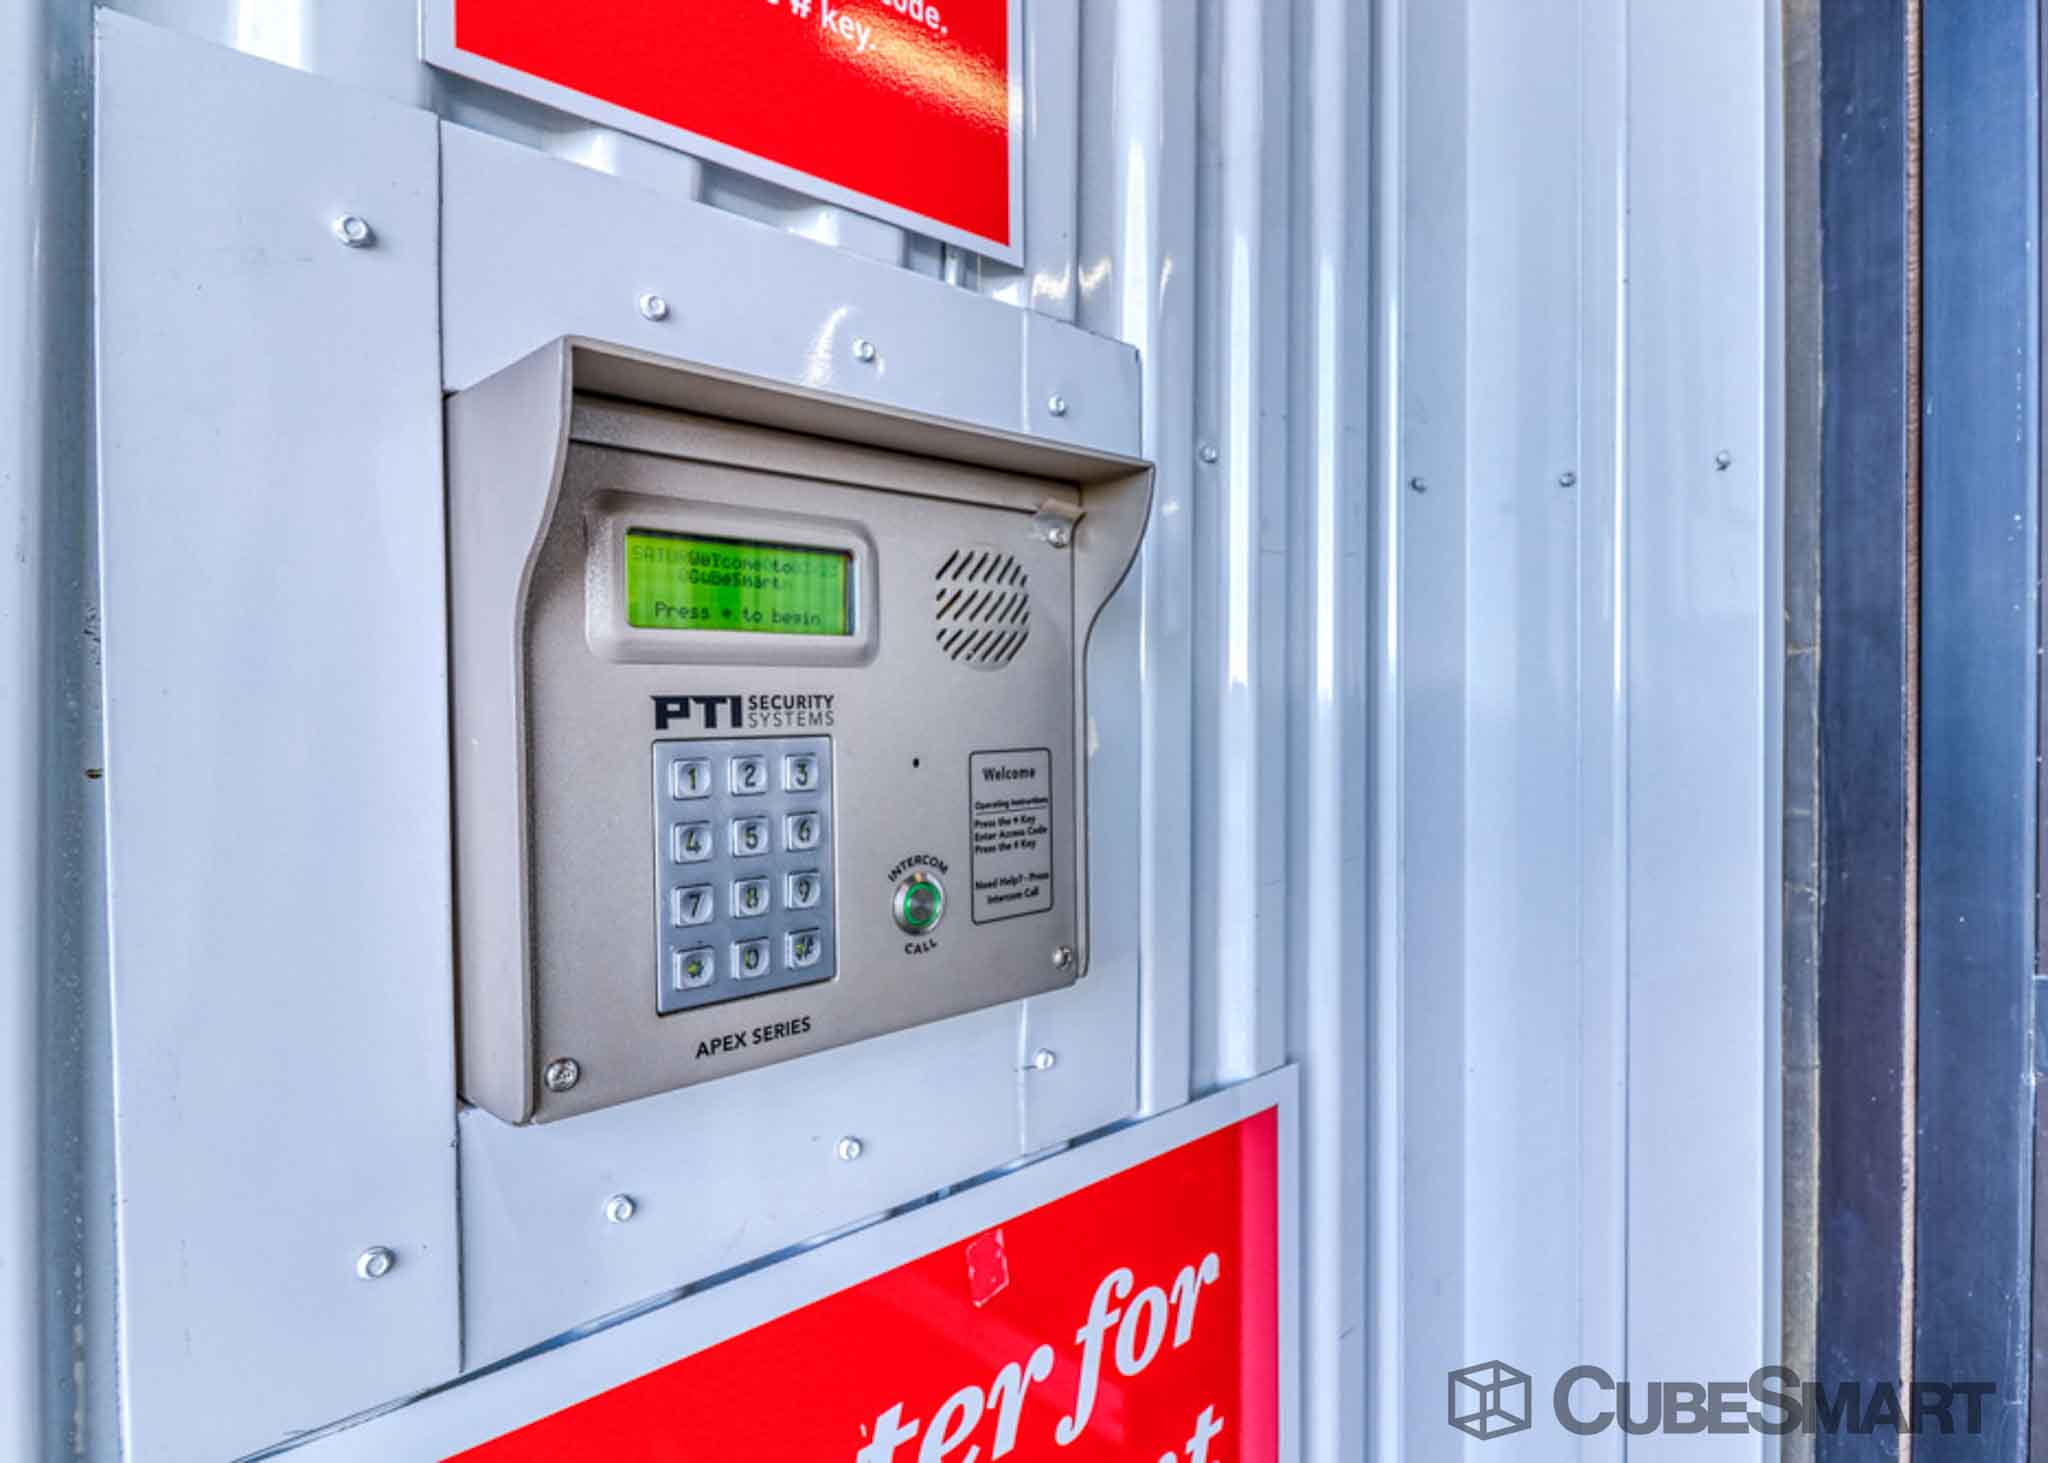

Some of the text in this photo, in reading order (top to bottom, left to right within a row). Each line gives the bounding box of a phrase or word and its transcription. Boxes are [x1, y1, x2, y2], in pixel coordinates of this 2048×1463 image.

[820, 0, 877, 53] key.
[881, 0, 948, 35] ode.
[688, 549, 762, 572] Welcome
[771, 557, 793, 576] to
[654, 601, 710, 621] Press
[743, 609, 763, 625] to
[772, 608, 822, 627] begin
[651, 695, 743, 730] PTI
[748, 694, 835, 711] SECURITY
[748, 710, 835, 729] SYSTEMS
[687, 762, 809, 791] 1 2 3
[982, 765, 1036, 782] Welcome
[975, 818, 997, 829] Press
[998, 815, 1012, 827] the
[1020, 815, 1036, 826] Key
[685, 819, 811, 854] 4 5 6
[975, 831, 997, 842] Enter
[975, 844, 997, 855] Press
[998, 841, 1012, 853] the
[1020, 838, 1036, 850] Key
[888, 854, 949, 882] INTERCOM
[688, 879, 811, 918] 7 8 9
[744, 947, 760, 970] 0
[904, 938, 938, 955] CALL
[695, 1015, 811, 1060] APEX SERIES
[1055, 1252, 1220, 1447] for
